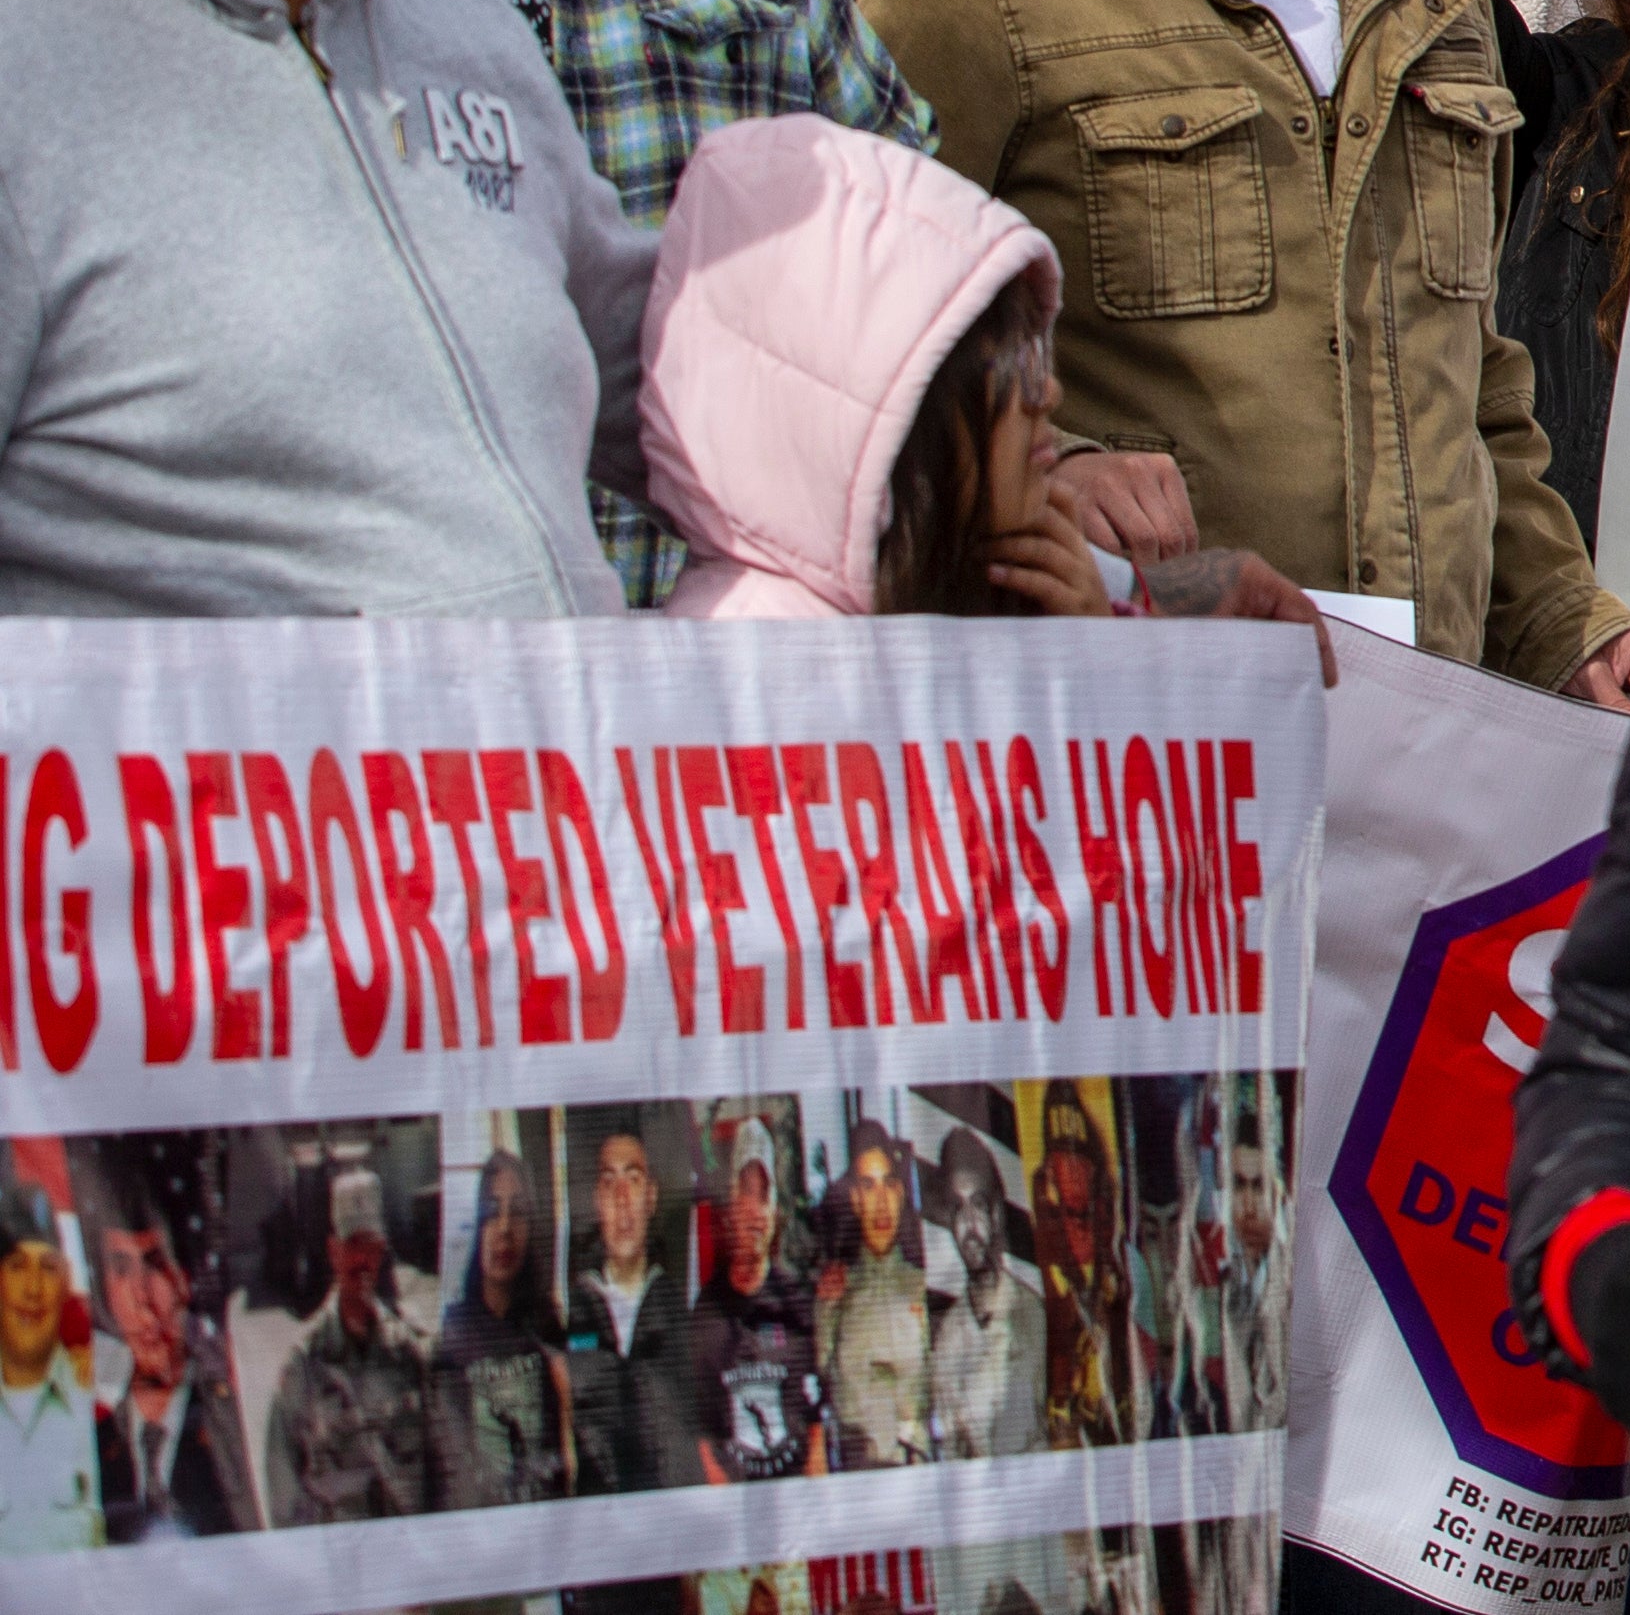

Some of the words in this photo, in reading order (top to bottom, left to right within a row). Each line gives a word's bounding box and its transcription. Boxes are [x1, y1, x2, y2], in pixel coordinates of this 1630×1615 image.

[117, 746, 627, 1064] DEPORTED
[615, 735, 1069, 1038] VETERANS
[1067, 735, 1264, 1020] HOME
[1399, 1160, 1508, 1262] DE
[1446, 1476, 1490, 1513] FB:
[1433, 1508, 1476, 1544] IG:
[1420, 1541, 1466, 1577] RT:
